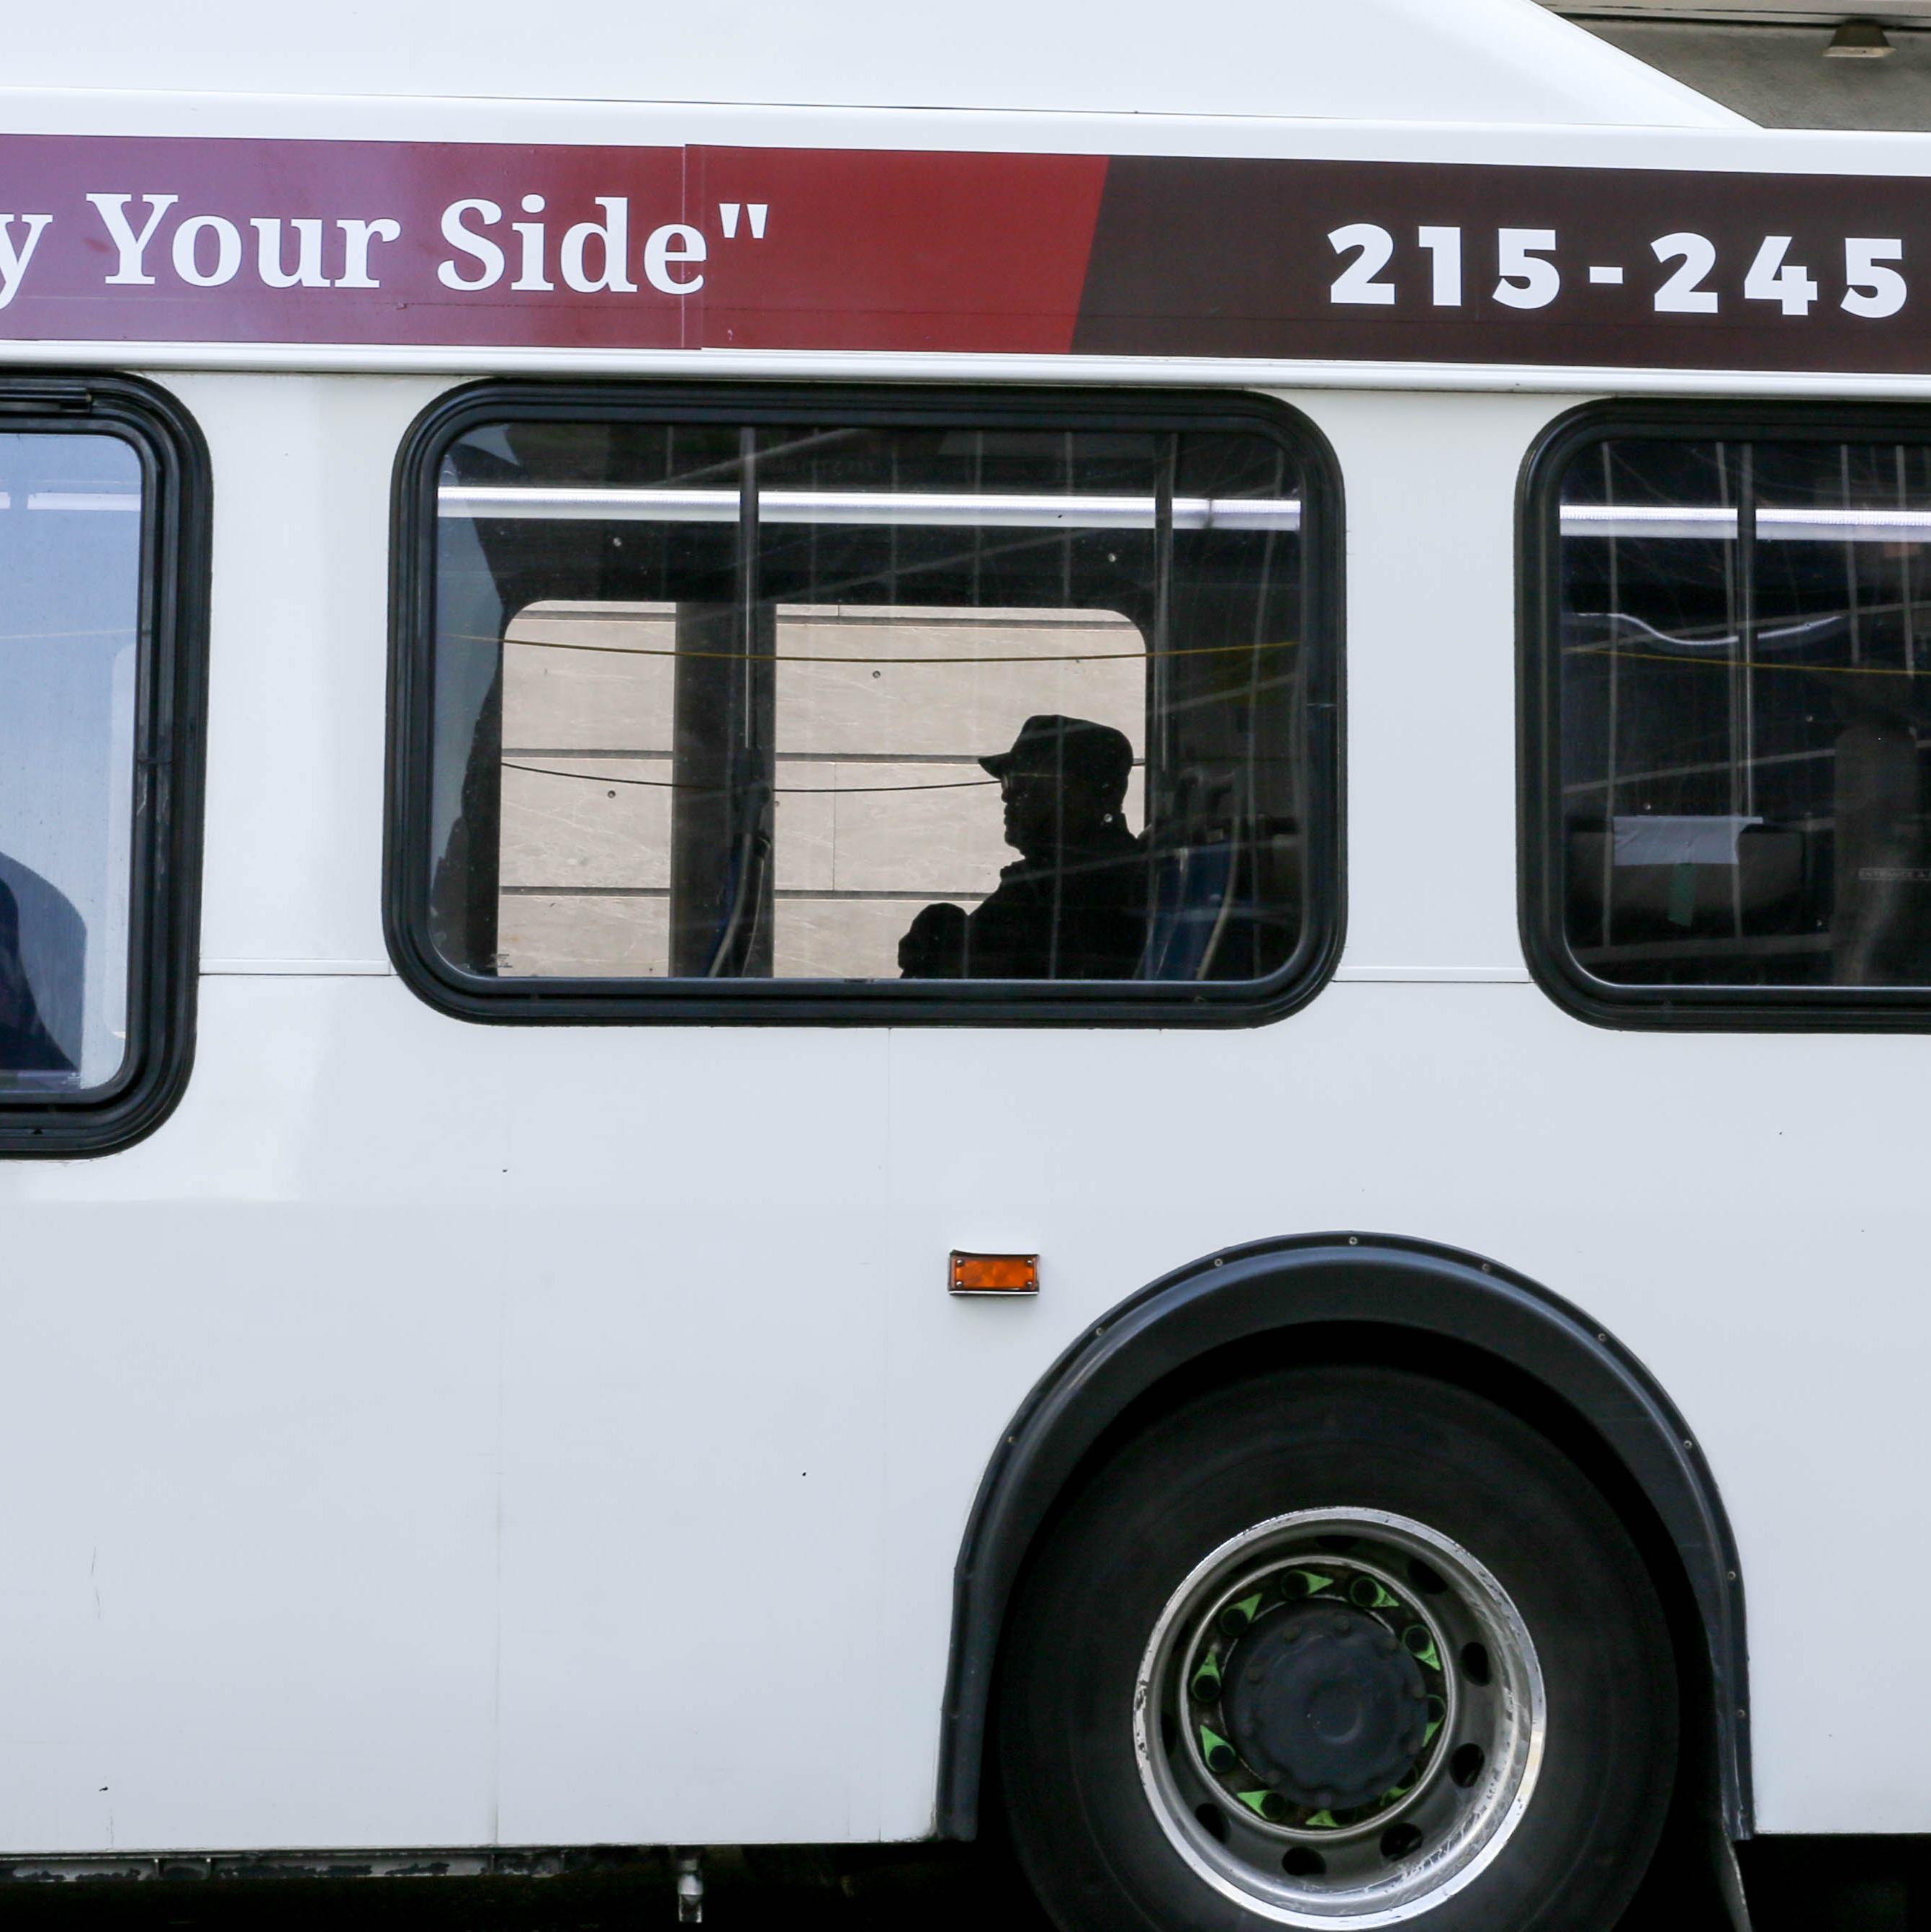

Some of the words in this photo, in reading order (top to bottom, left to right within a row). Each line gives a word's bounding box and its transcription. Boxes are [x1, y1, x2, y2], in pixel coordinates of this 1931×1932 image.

[85, 192, 402, 289] Your
[436, 194, 768, 295] Side"
[1326, 223, 1908, 319] 215-245
